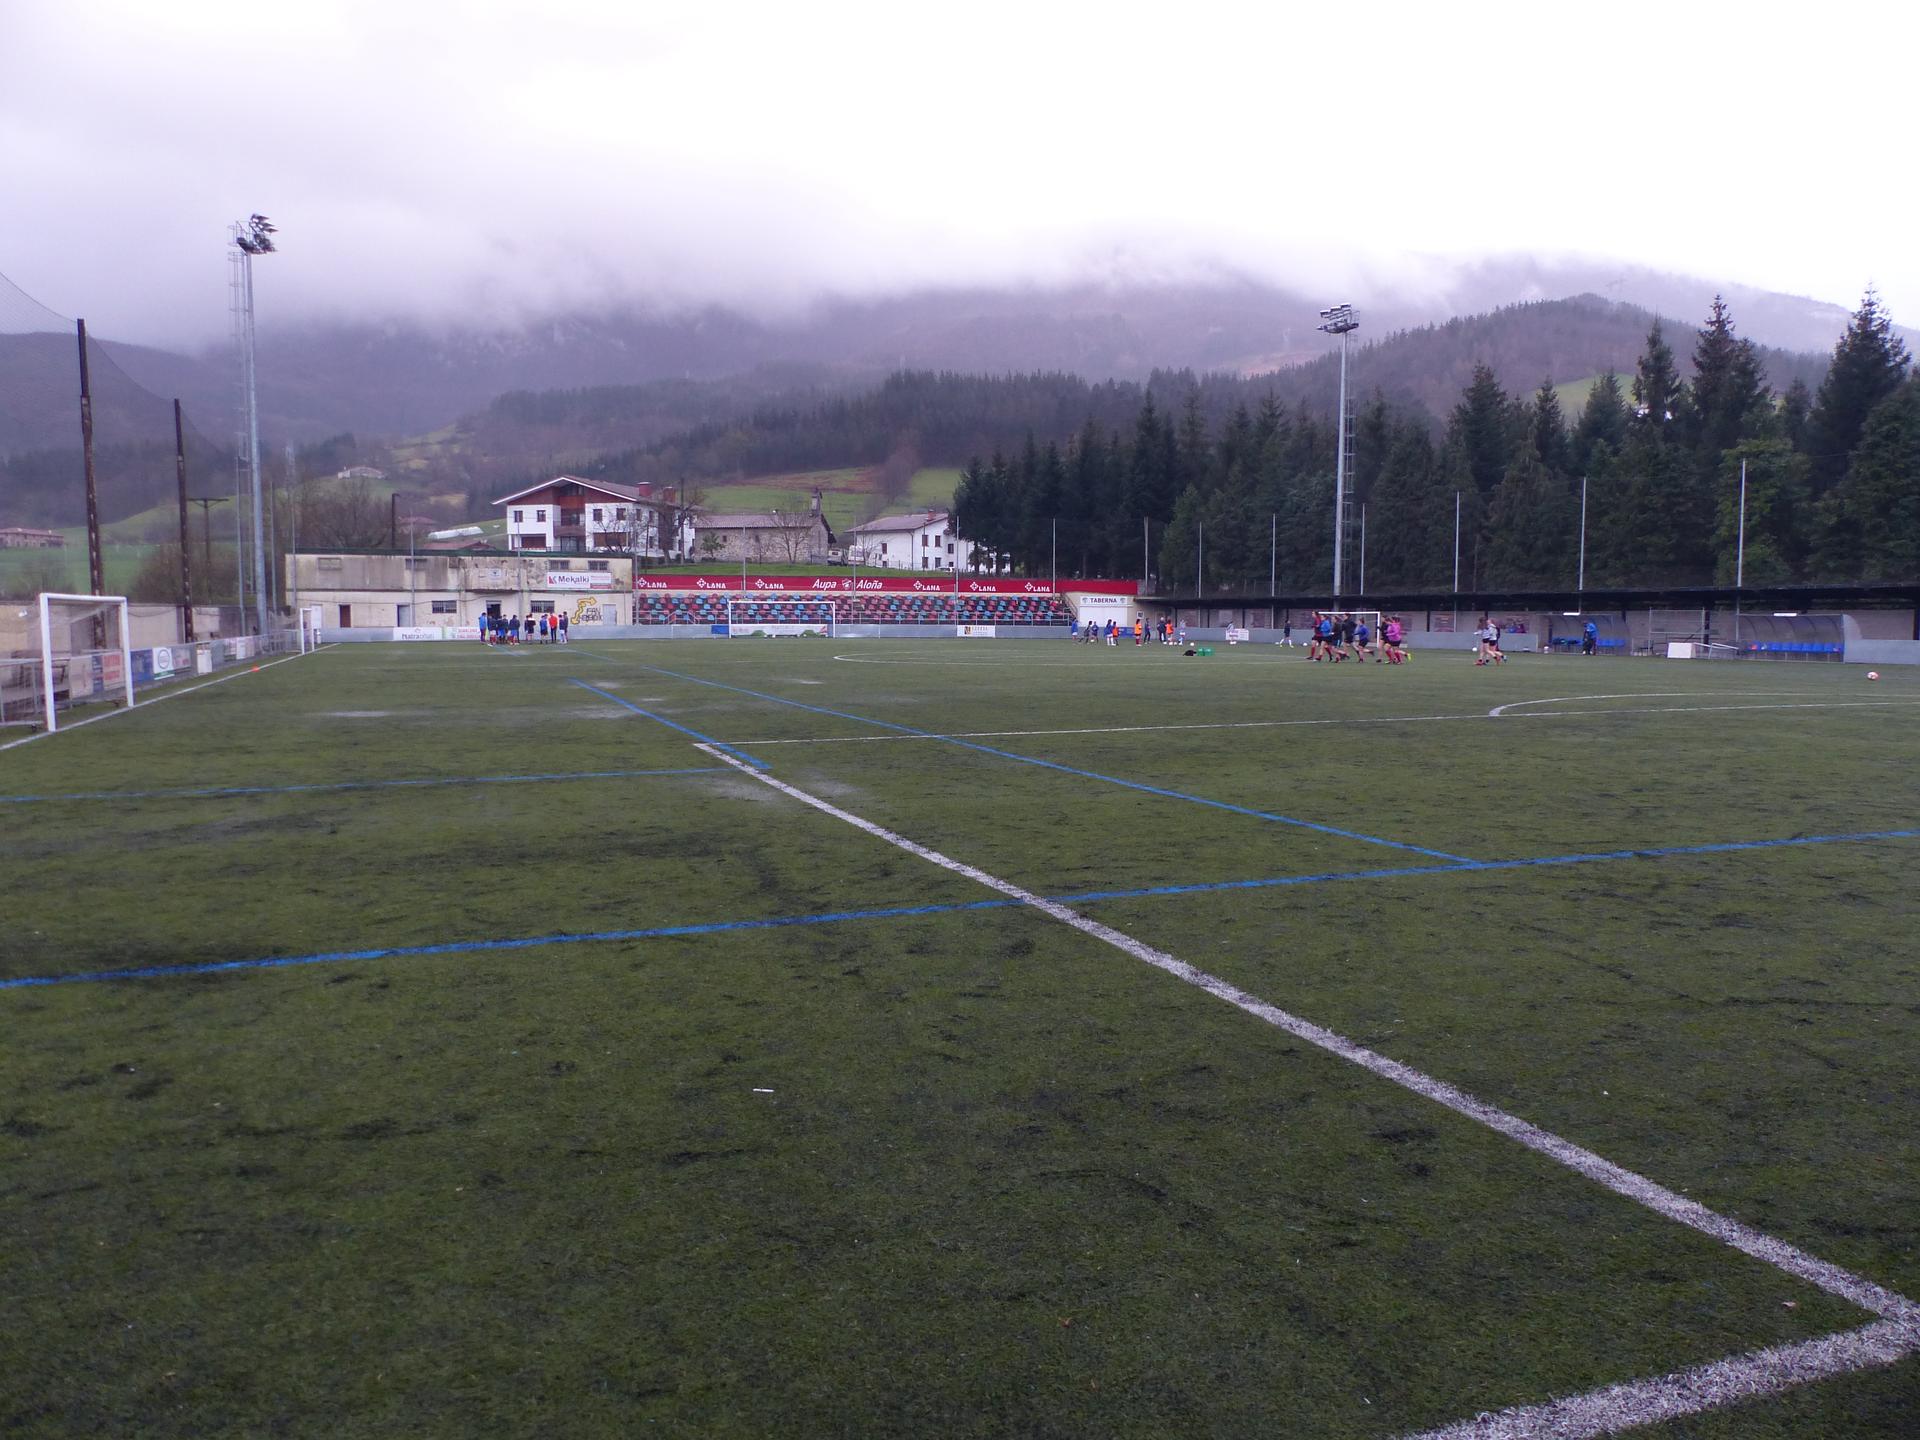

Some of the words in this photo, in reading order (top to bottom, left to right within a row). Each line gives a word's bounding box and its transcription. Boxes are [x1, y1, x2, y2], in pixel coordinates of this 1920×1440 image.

[558, 575, 590, 584] Mekalki
[812, 579, 837, 590] Aupa
[856, 579, 883, 590] Aloña
